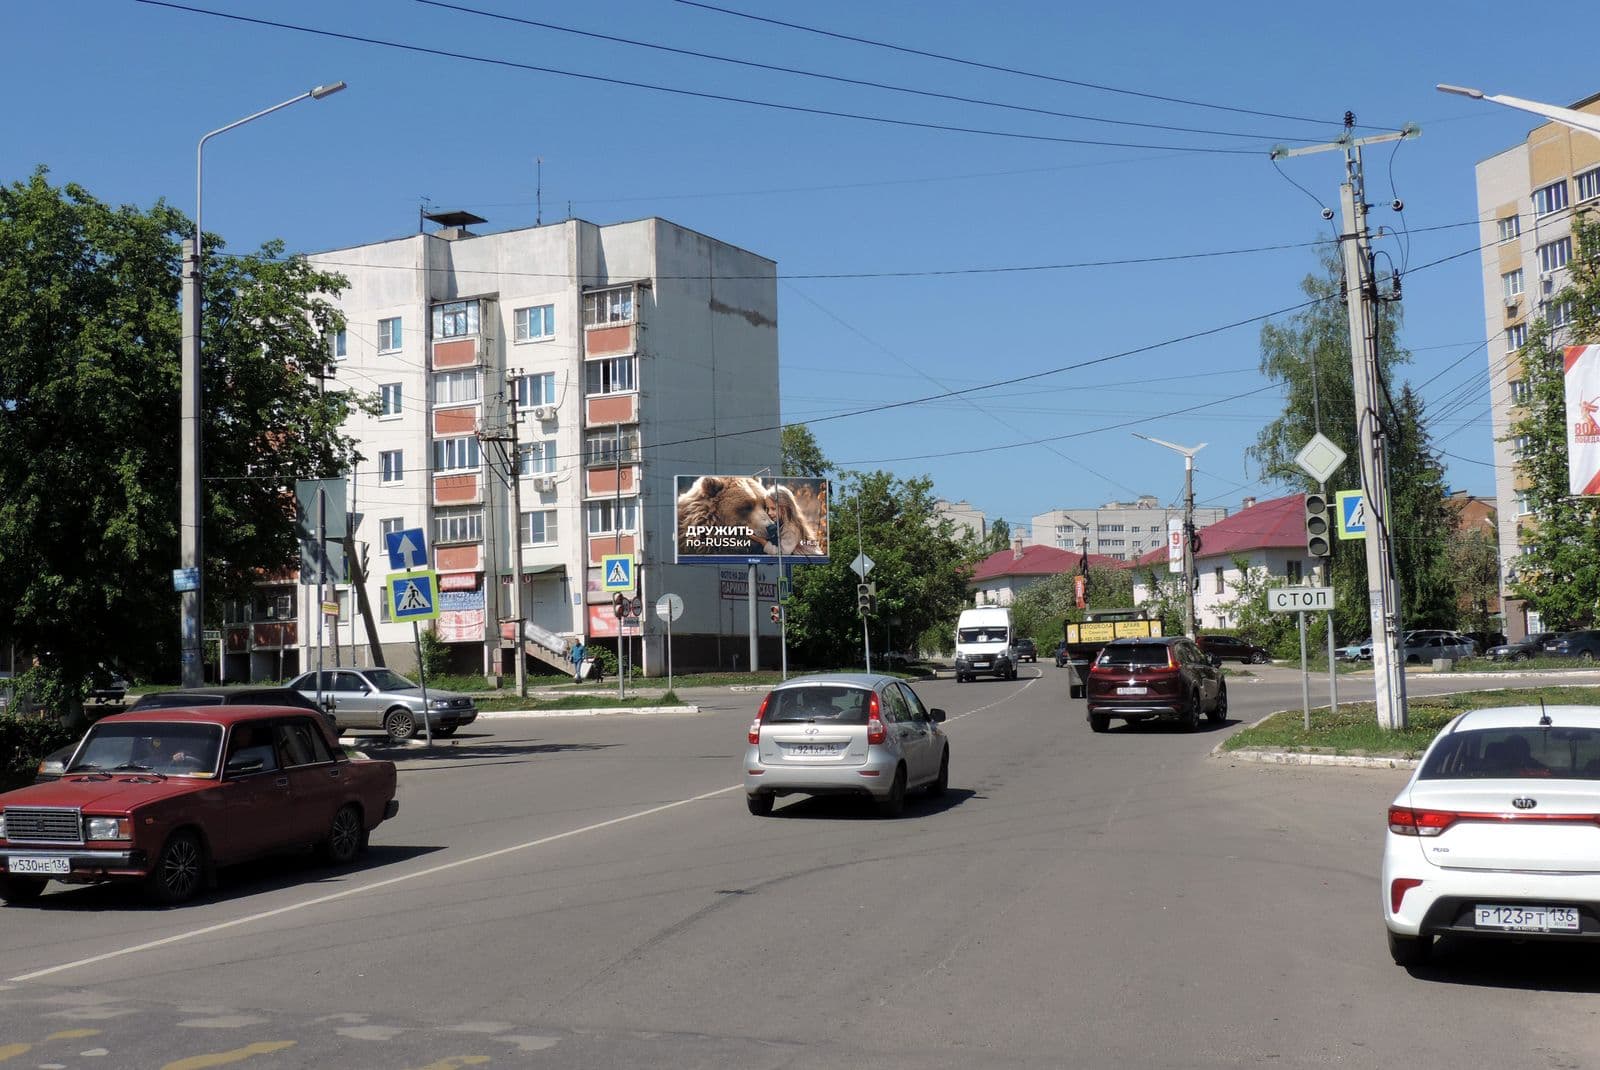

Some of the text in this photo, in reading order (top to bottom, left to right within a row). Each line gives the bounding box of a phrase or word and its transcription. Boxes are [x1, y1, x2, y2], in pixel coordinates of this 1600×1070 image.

[686, 526, 754, 537] ДРУЖИТЬ
[686, 537, 751, 547] по-RUSSки
[1172, 532, 1180, 545] 9
[1277, 592, 1326, 606] СТОП
[1515, 799, 1533, 808] KIA
[1481, 907, 1573, 925] Р123РТ 136
